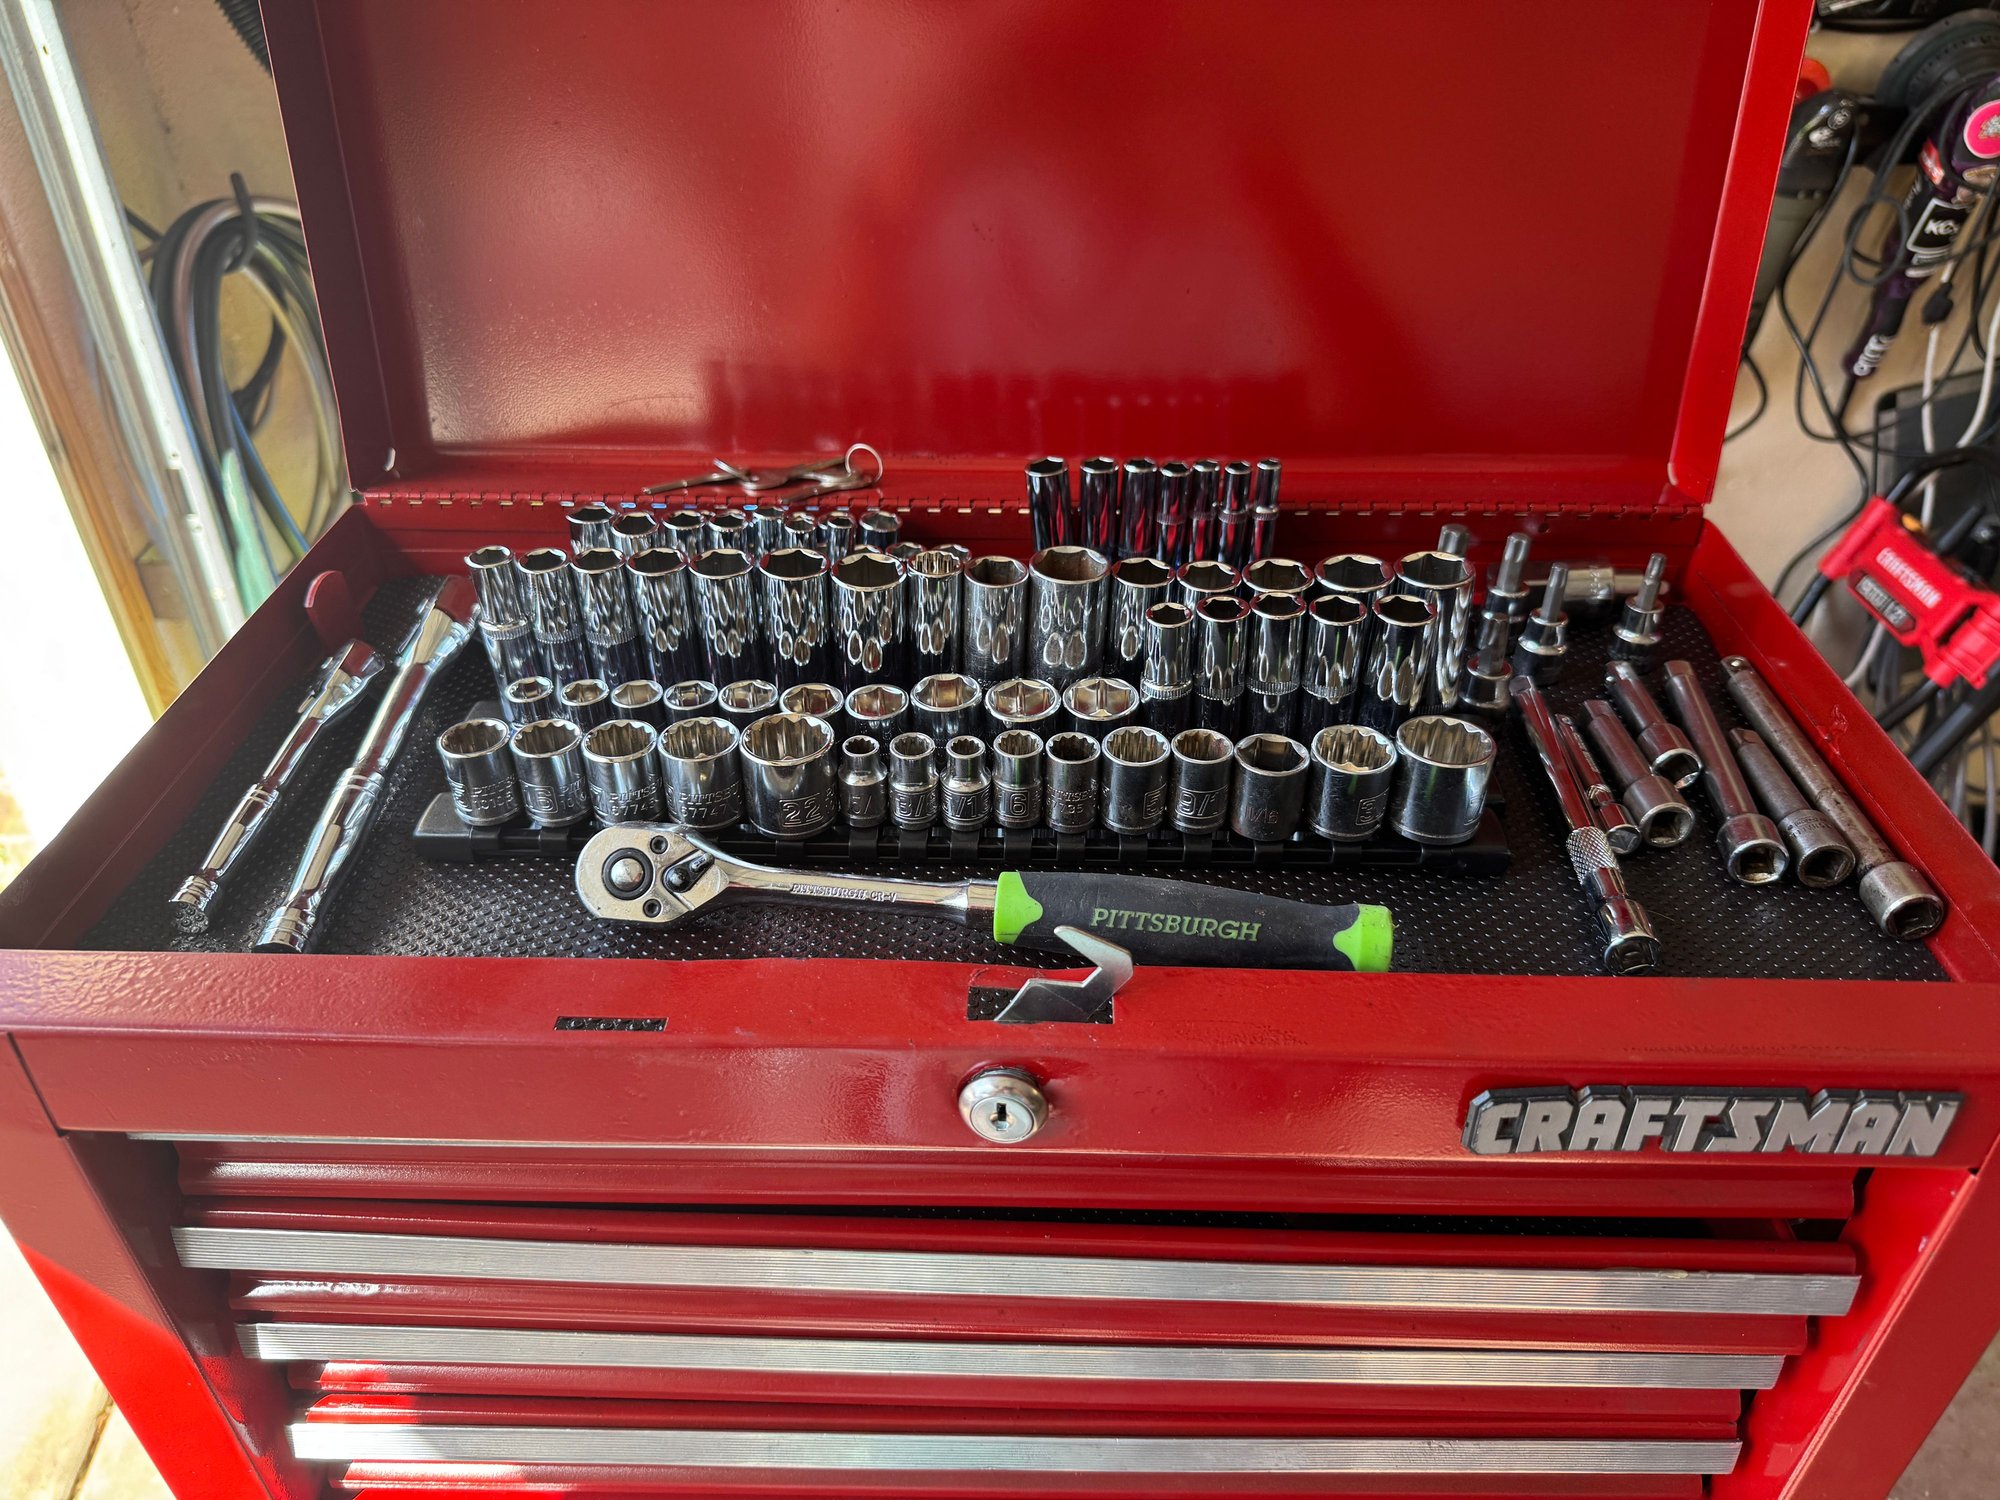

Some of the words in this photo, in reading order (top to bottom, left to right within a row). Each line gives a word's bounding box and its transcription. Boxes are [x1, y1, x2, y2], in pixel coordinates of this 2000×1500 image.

[782, 797, 823, 825] 22
[791, 883, 867, 900] PITTSBURGH
[870, 890, 898, 903] CR-V
[1090, 908, 1262, 942] PITTSBURGH
[1476, 1099, 1960, 1157] CRAFTSMAN
